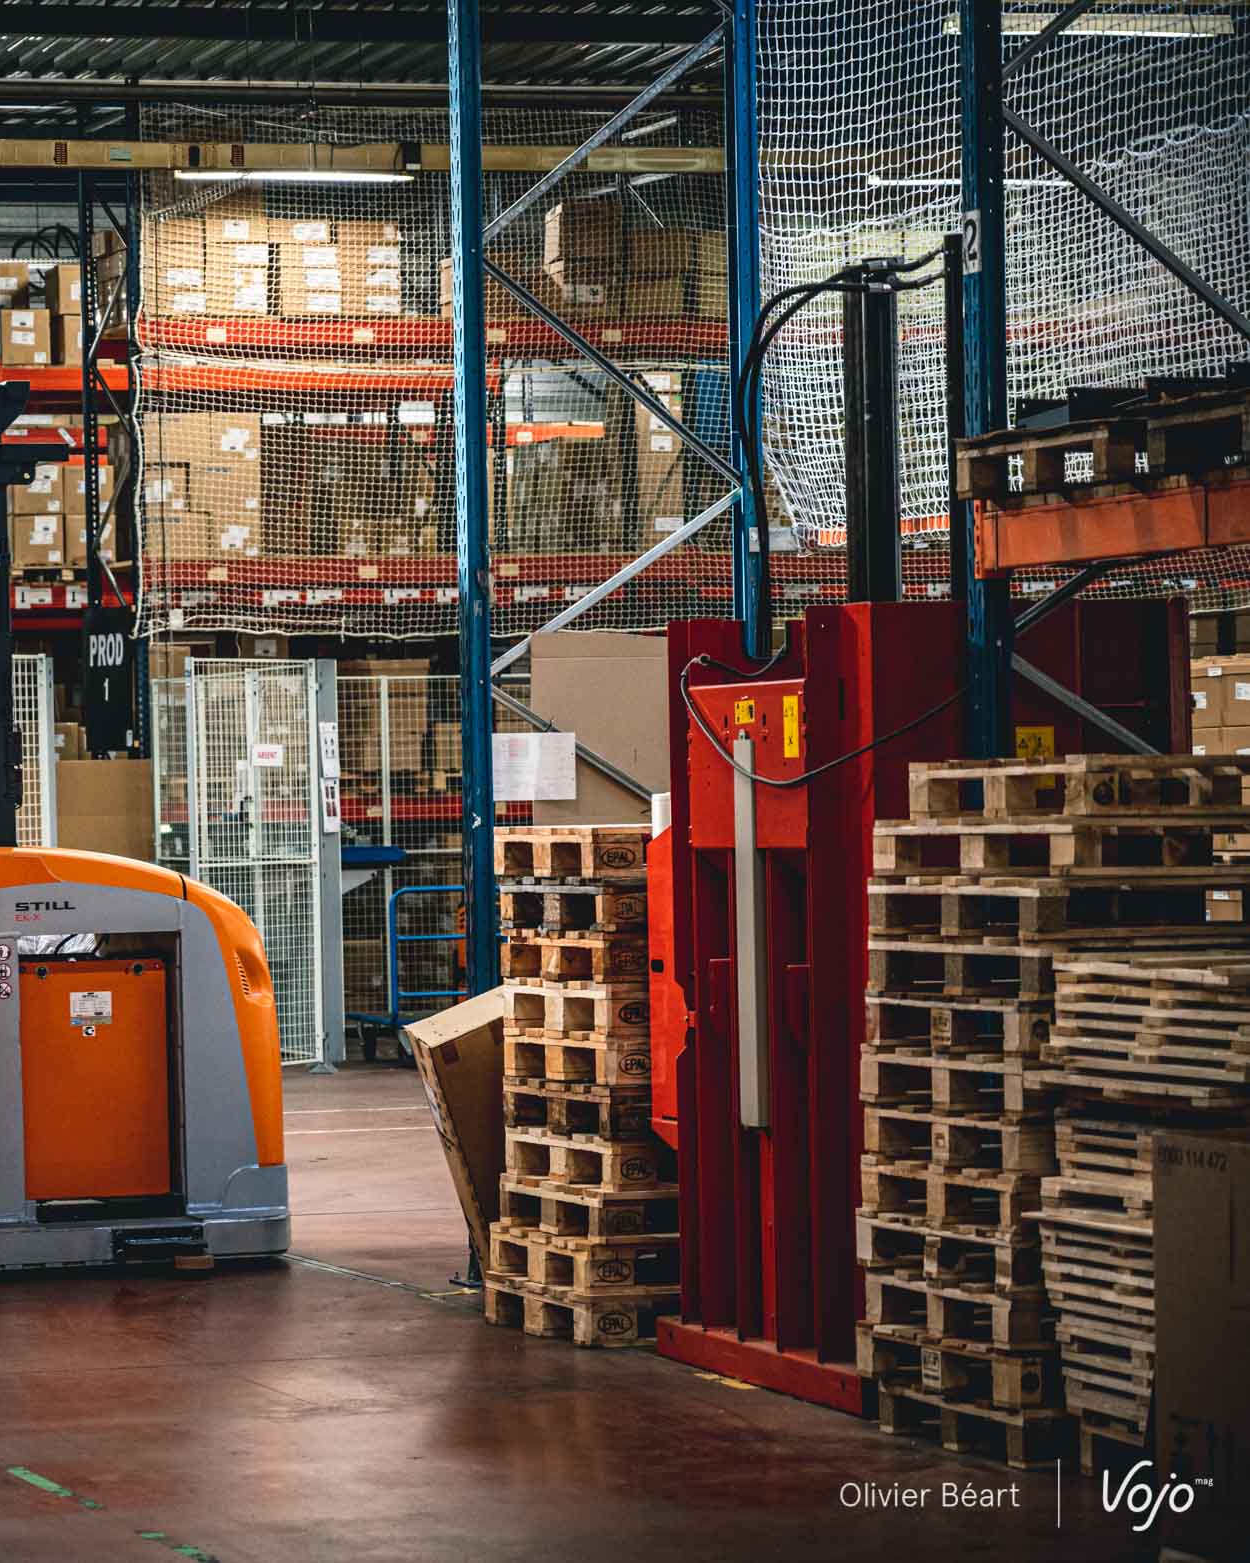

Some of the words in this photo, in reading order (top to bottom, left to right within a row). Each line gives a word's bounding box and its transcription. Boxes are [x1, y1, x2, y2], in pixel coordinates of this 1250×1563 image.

[964, 219, 978, 261] 2
[89, 633, 124, 667] PROD
[103, 677, 109, 701] 1
[15, 901, 76, 911] STILL
[14, 913, 41, 922] EK-X
[624, 1057, 647, 1073] EPAL
